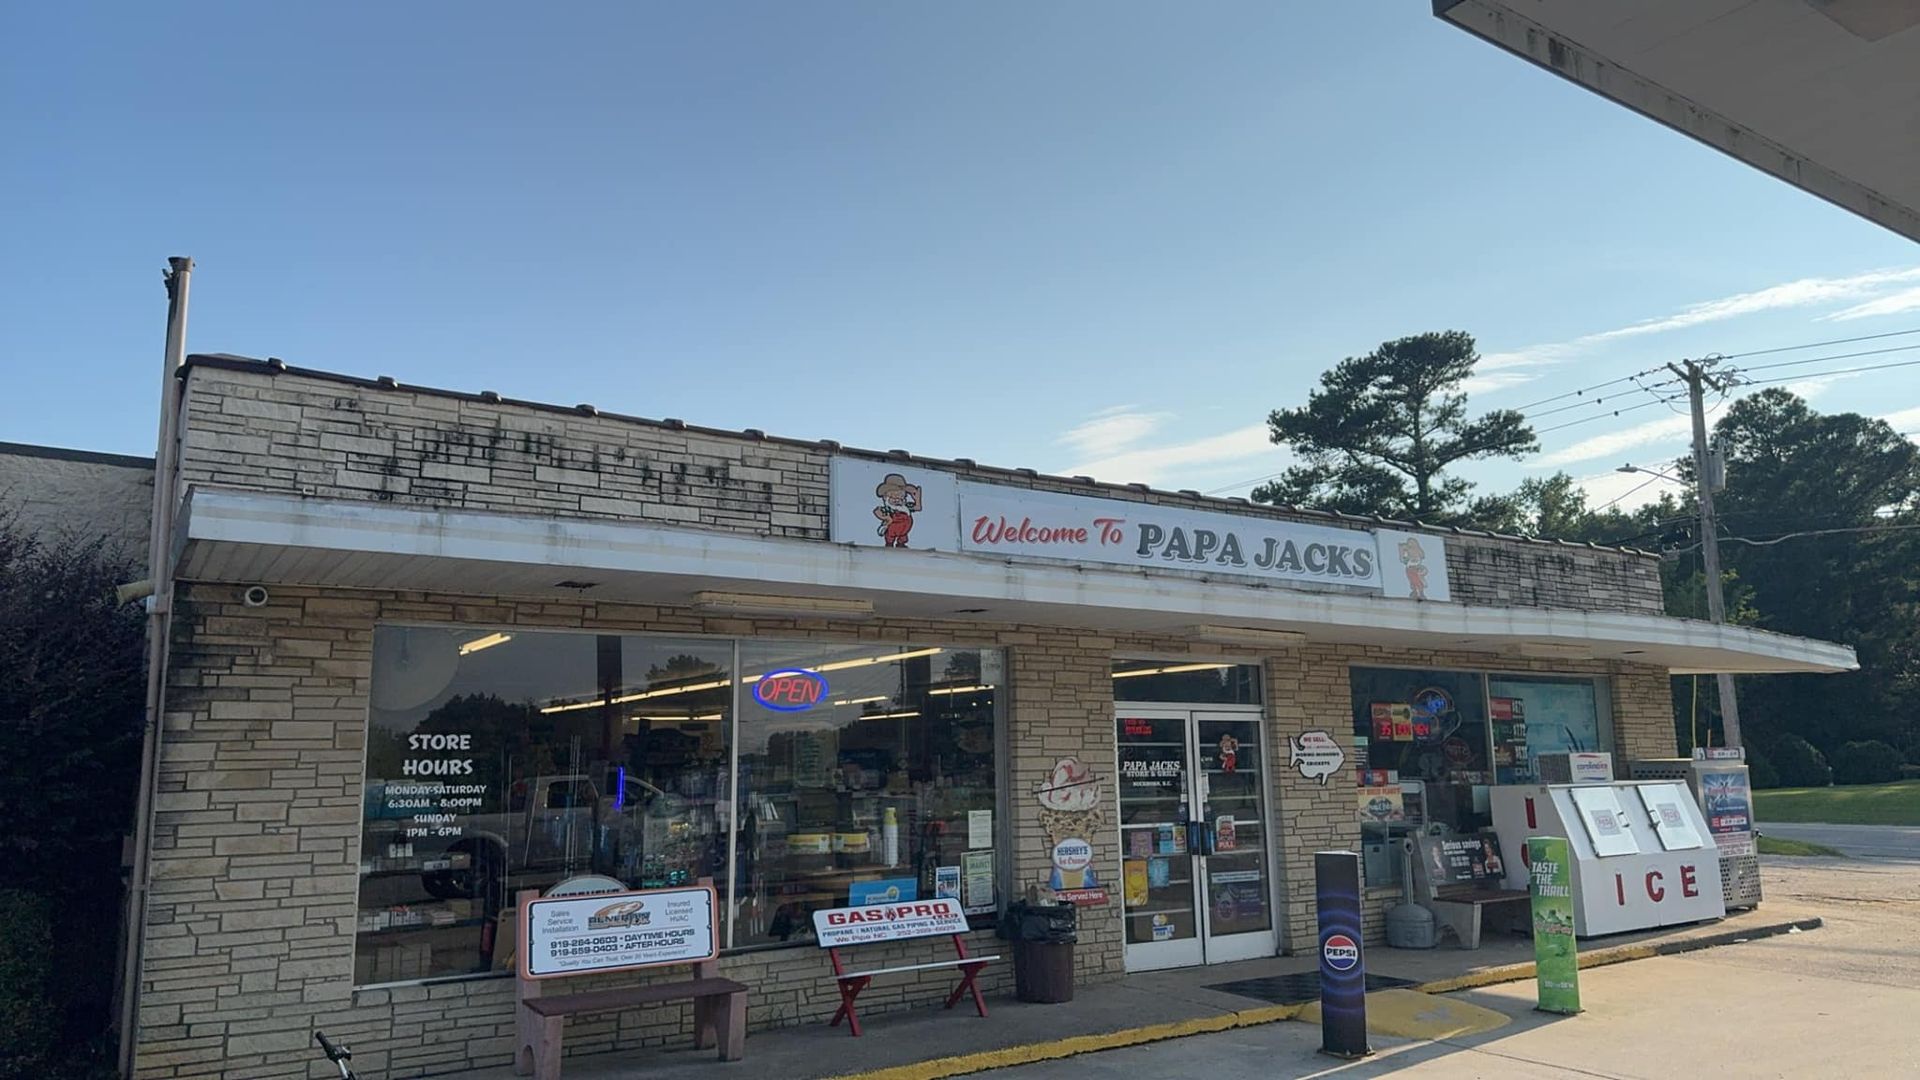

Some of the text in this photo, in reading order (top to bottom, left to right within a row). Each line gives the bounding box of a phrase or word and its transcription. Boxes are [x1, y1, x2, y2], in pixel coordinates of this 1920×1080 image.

[972, 515, 1372, 579] Welcome To PAPA JACKS
[758, 678, 821, 703] OPEN
[408, 734, 471, 750] STORE
[402, 759, 473, 775] HOURS
[1123, 760, 1181, 771] PAPA JACKS
[385, 785, 487, 795] MONDAY-SATURDAY
[388, 799, 430, 808] 6:30AM
[440, 798, 482, 807] 8:00PM
[414, 813, 457, 823] SUNDAY
[407, 828, 427, 837] 1PM
[438, 827, 462, 836] 6PM
[1462, 839, 1481, 850] savings
[1532, 862, 1559, 873] TASTE
[1536, 873, 1553, 885] THE
[1539, 885, 1570, 897] THRILL
[1615, 865, 1699, 906] ICE
[1067, 892, 1088, 901] Served
[1089, 891, 1103, 899] Here
[667, 900, 690, 908] Insured
[550, 910, 570, 918] Sales
[665, 907, 693, 916] Licensed
[828, 903, 950, 925] GAS PRO
[547, 918, 573, 926] Service
[822, 928, 853, 937] PROPANE
[860, 925, 891, 933] NATURAL
[906, 921, 928, 930] PIPING
[936, 918, 962, 926] SERVICE
[542, 925, 579, 934] Installation
[624, 931, 664, 942] DAYTIME
[664, 928, 695, 938] HOURS
[624, 940, 653, 950] AFTER
[653, 937, 685, 947] HOURS
[1326, 948, 1356, 957] PEPSI
